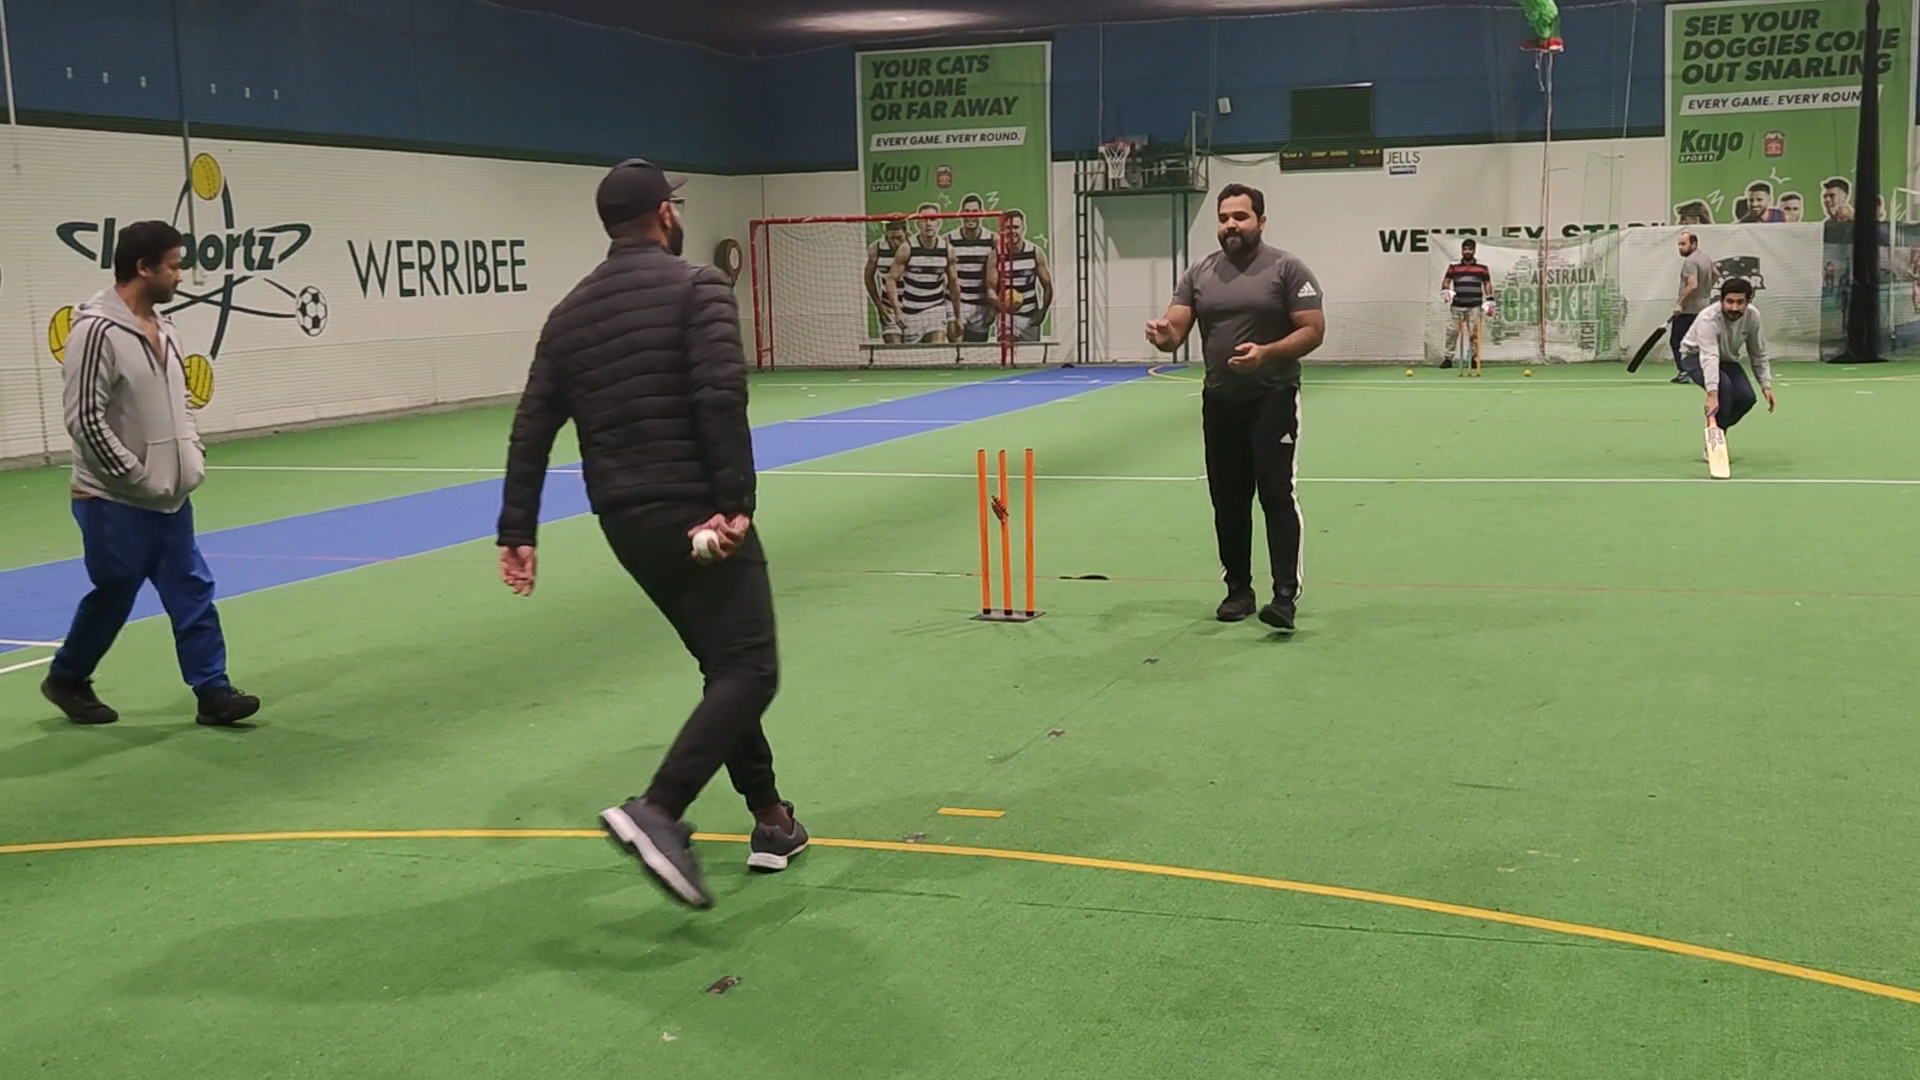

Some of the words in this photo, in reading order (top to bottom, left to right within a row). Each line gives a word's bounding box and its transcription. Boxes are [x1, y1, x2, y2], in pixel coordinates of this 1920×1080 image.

[1684, 14, 1734, 37] SEE
[1741, 9, 1821, 34] YOUR
[1683, 33, 1811, 62] DOGGIES
[871, 58, 932, 79] YOUR
[936, 55, 990, 76] CATS
[1681, 62, 1741, 85] OUT
[870, 82, 897, 100] AT
[900, 78, 968, 99] HOME
[1688, 98, 1727, 110] EVERY
[1731, 95, 1774, 108] GAME.
[1777, 93, 1818, 106] EVERY
[1821, 91, 1863, 103] ROUN
[870, 103, 902, 121] OR
[906, 101, 947, 119] FAR
[951, 97, 1019, 118] AWAY
[876, 136, 909, 147] EVERY
[910, 135, 943, 145] GAME.
[945, 134, 978, 144] EVERY
[980, 132, 1021, 142] ROUND.
[1680, 129, 1744, 161] Kayo
[1386, 151, 1421, 165] JELLS
[1680, 154, 1714, 163] SPORTS
[872, 162, 921, 191] Kayo
[347, 239, 528, 299] WERRIBEE
